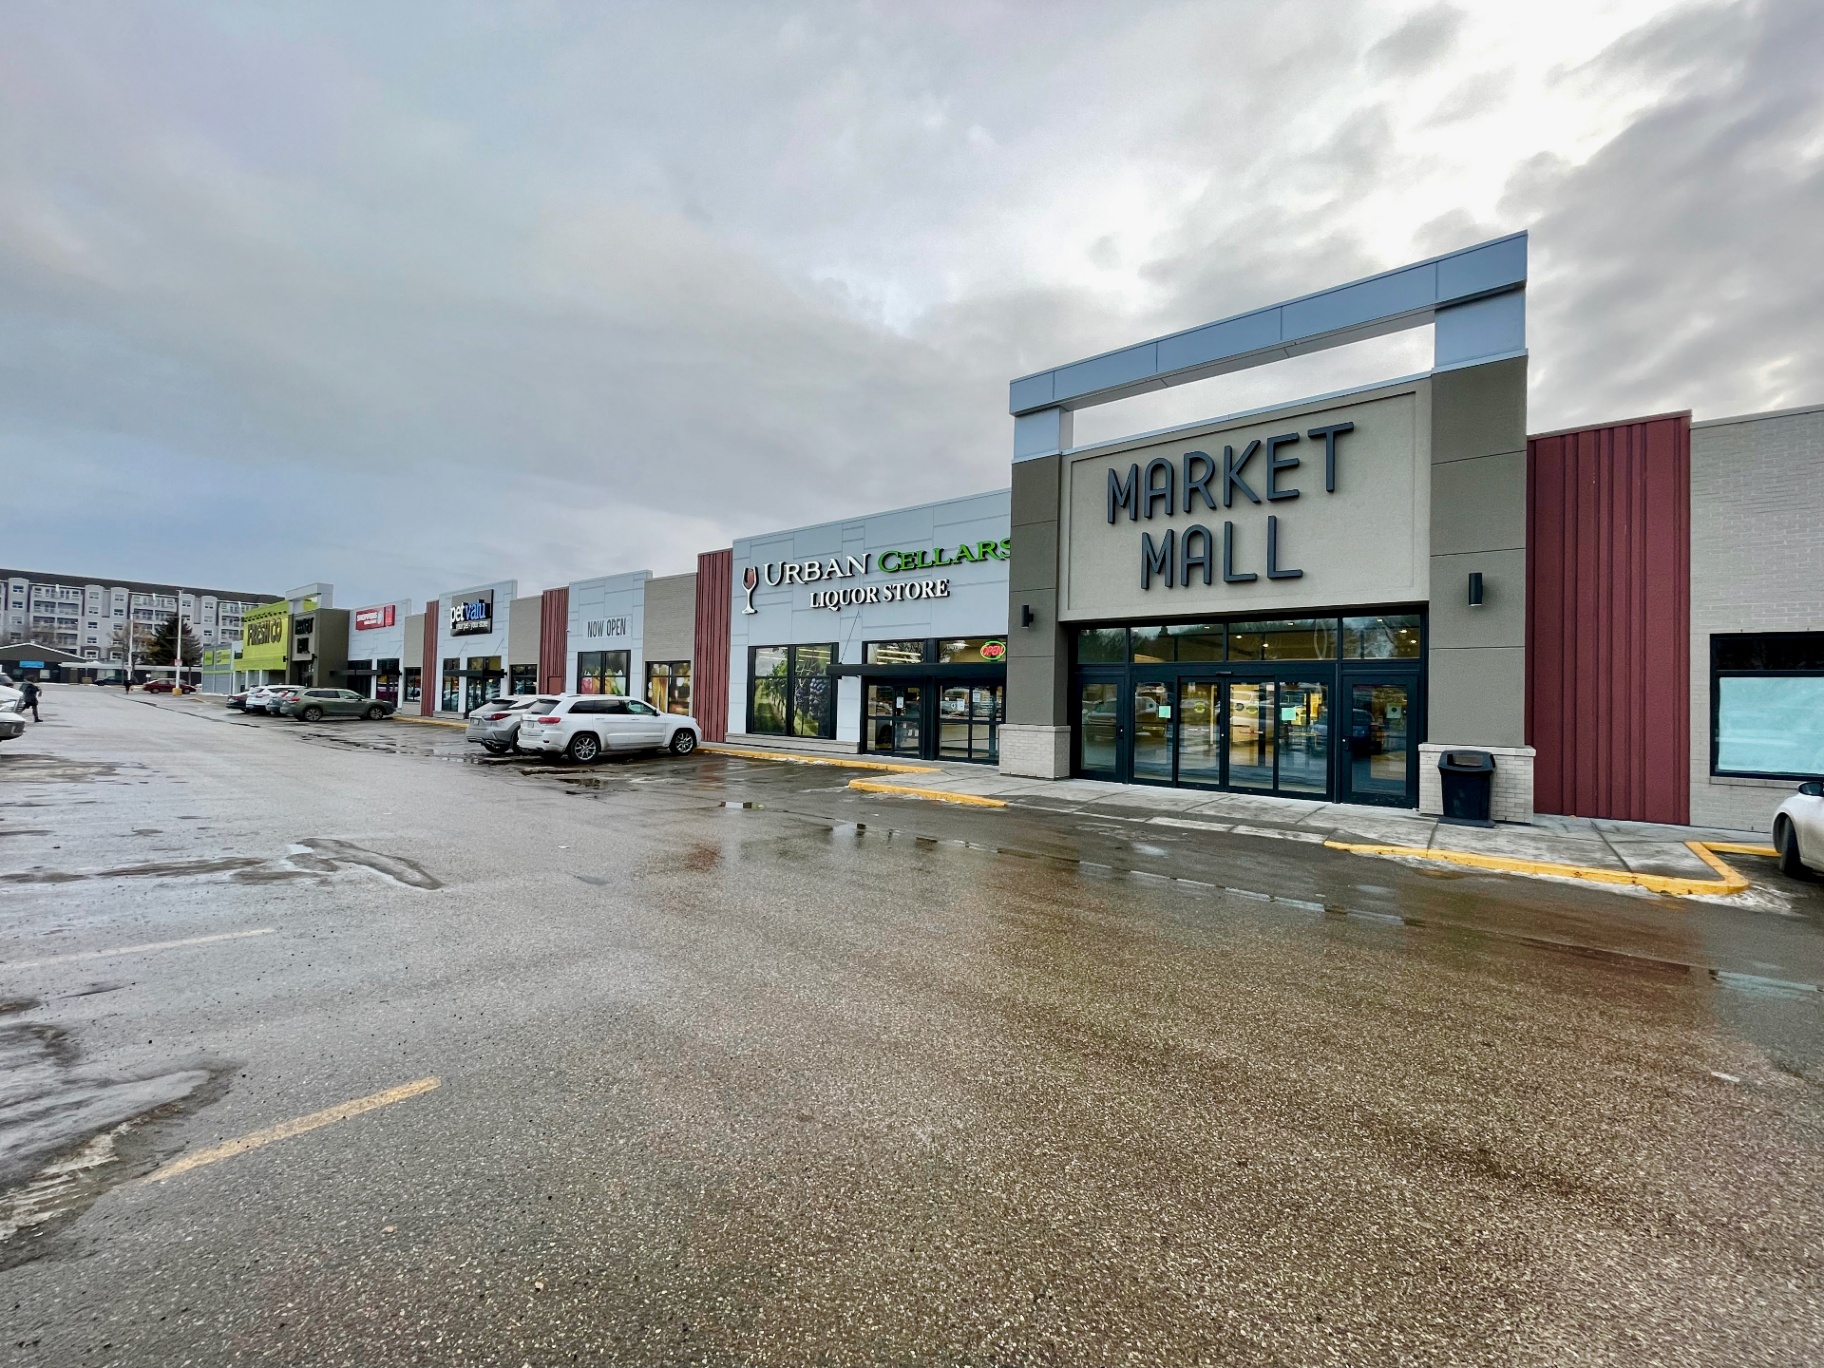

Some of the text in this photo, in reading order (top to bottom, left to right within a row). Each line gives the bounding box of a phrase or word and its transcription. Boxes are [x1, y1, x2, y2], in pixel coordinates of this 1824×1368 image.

[1106, 421, 1355, 525] MARKET
[763, 537, 1011, 587] URBAN CELLARS
[1140, 515, 1304, 591] MALL
[809, 578, 951, 612] LIQUOR STORE
[587, 617, 627, 639] NOW OPEN
